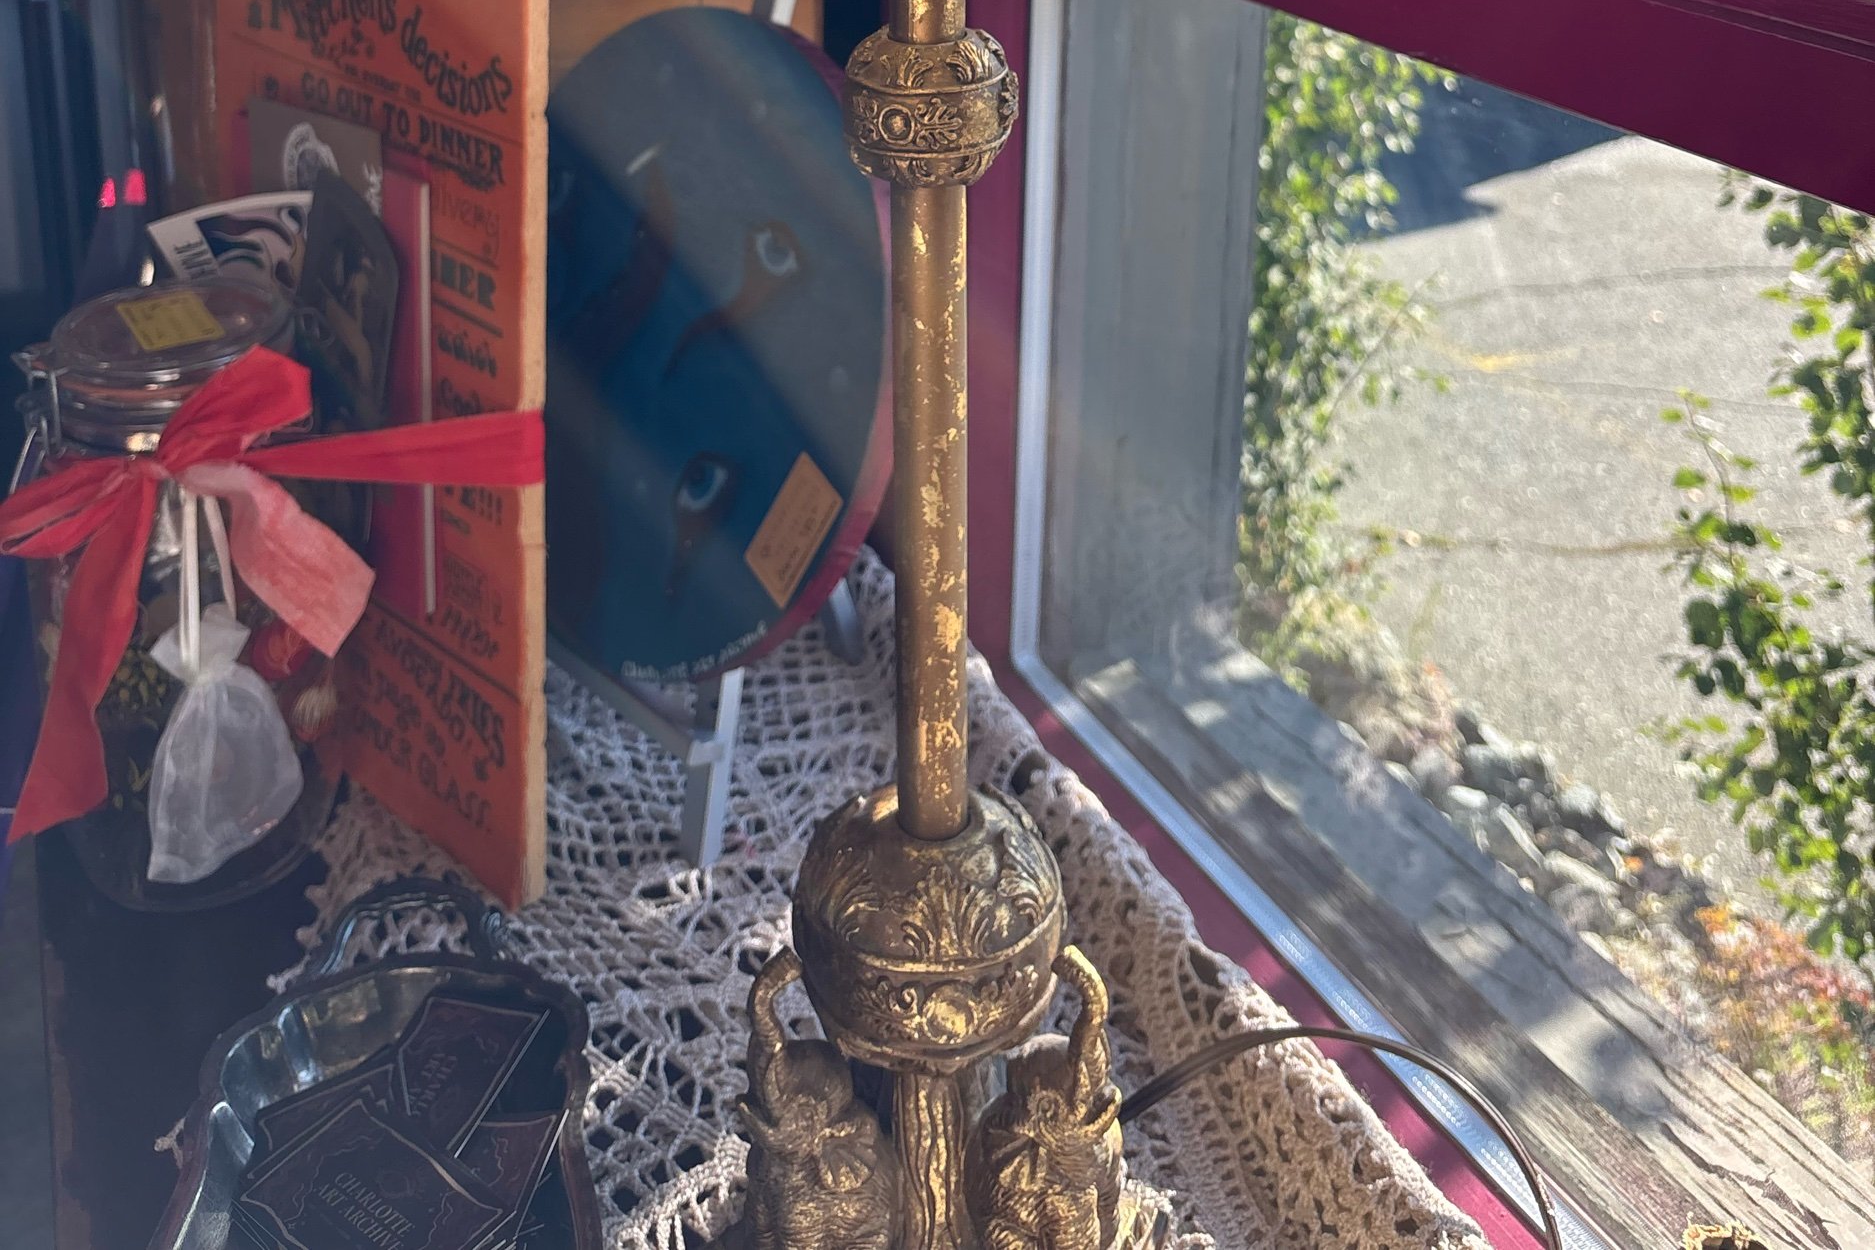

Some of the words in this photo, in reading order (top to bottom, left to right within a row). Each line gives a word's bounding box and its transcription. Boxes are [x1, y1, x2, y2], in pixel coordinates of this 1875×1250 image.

[400, 4, 513, 117] decisions
[302, 71, 330, 107] GO
[336, 85, 374, 128] OUT
[382, 102, 411, 139] TO
[418, 113, 505, 185] DINNER
[312, 1183, 348, 1207] ART
[335, 1172, 416, 1238] CHARLOTTE
